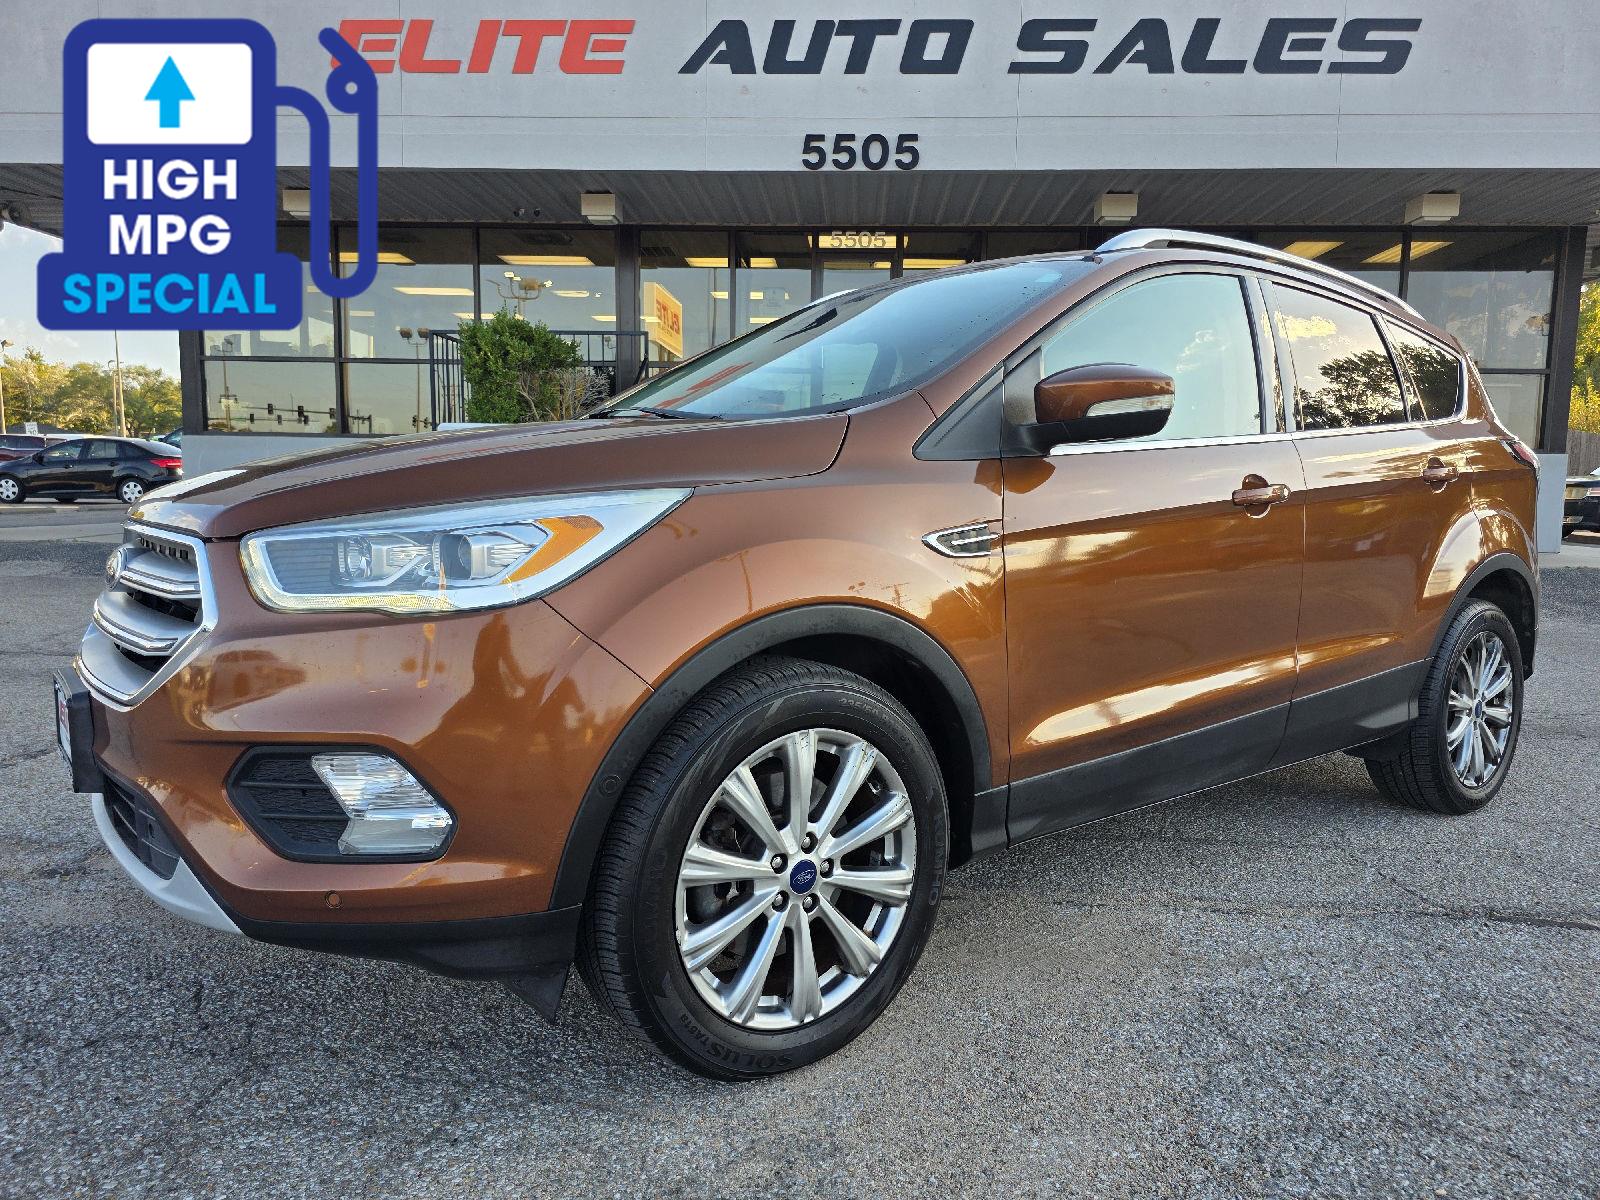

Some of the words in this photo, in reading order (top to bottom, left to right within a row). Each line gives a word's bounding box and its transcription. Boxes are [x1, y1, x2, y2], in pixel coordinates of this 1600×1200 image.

[331, 19, 635, 74] ELITE
[678, 18, 975, 75] AUTO
[1008, 17, 1423, 75] SALES
[802, 133, 919, 169] 5505
[830, 231, 887, 248] 5505
